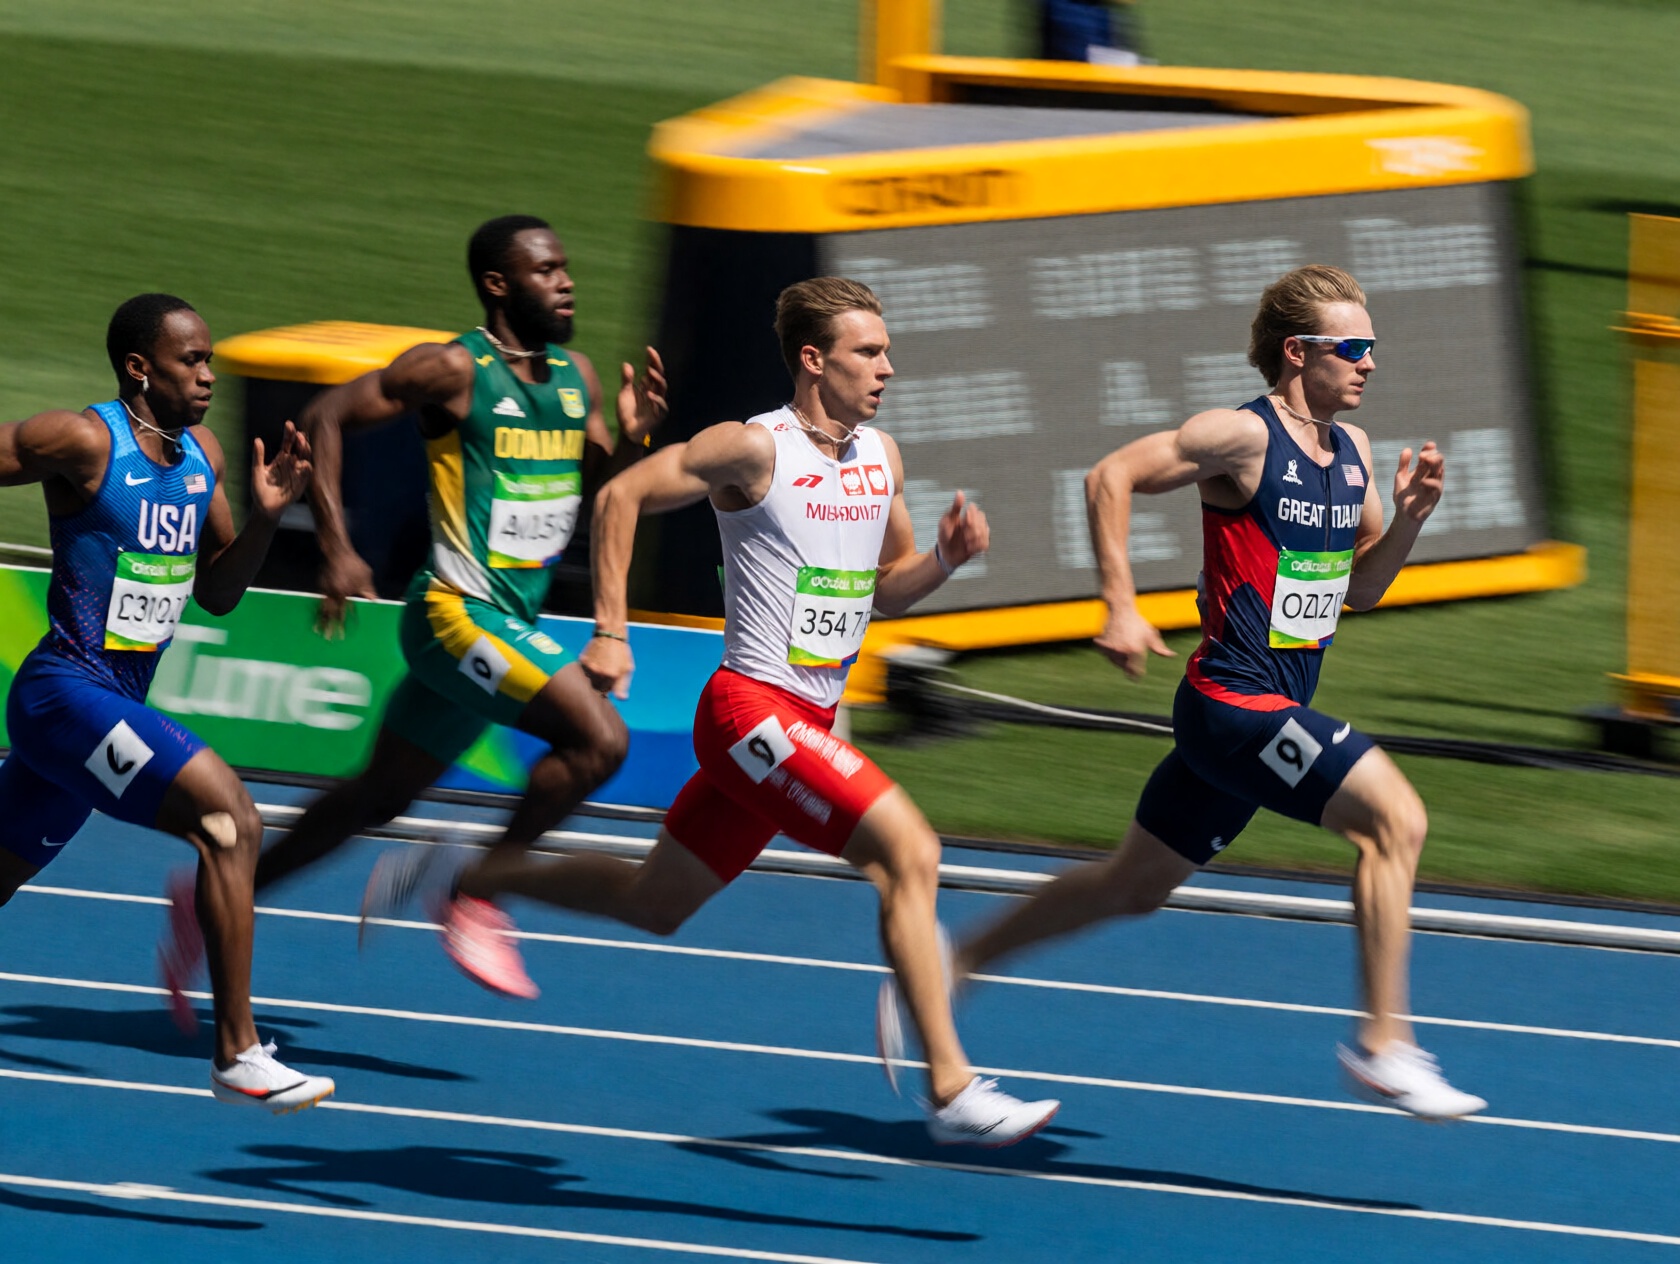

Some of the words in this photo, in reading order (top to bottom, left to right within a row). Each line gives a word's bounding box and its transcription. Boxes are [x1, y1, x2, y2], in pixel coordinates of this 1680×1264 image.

[137, 498, 197, 553] USA
[1278, 497, 1326, 528] GREAT
[1276, 738, 1304, 773] 9
